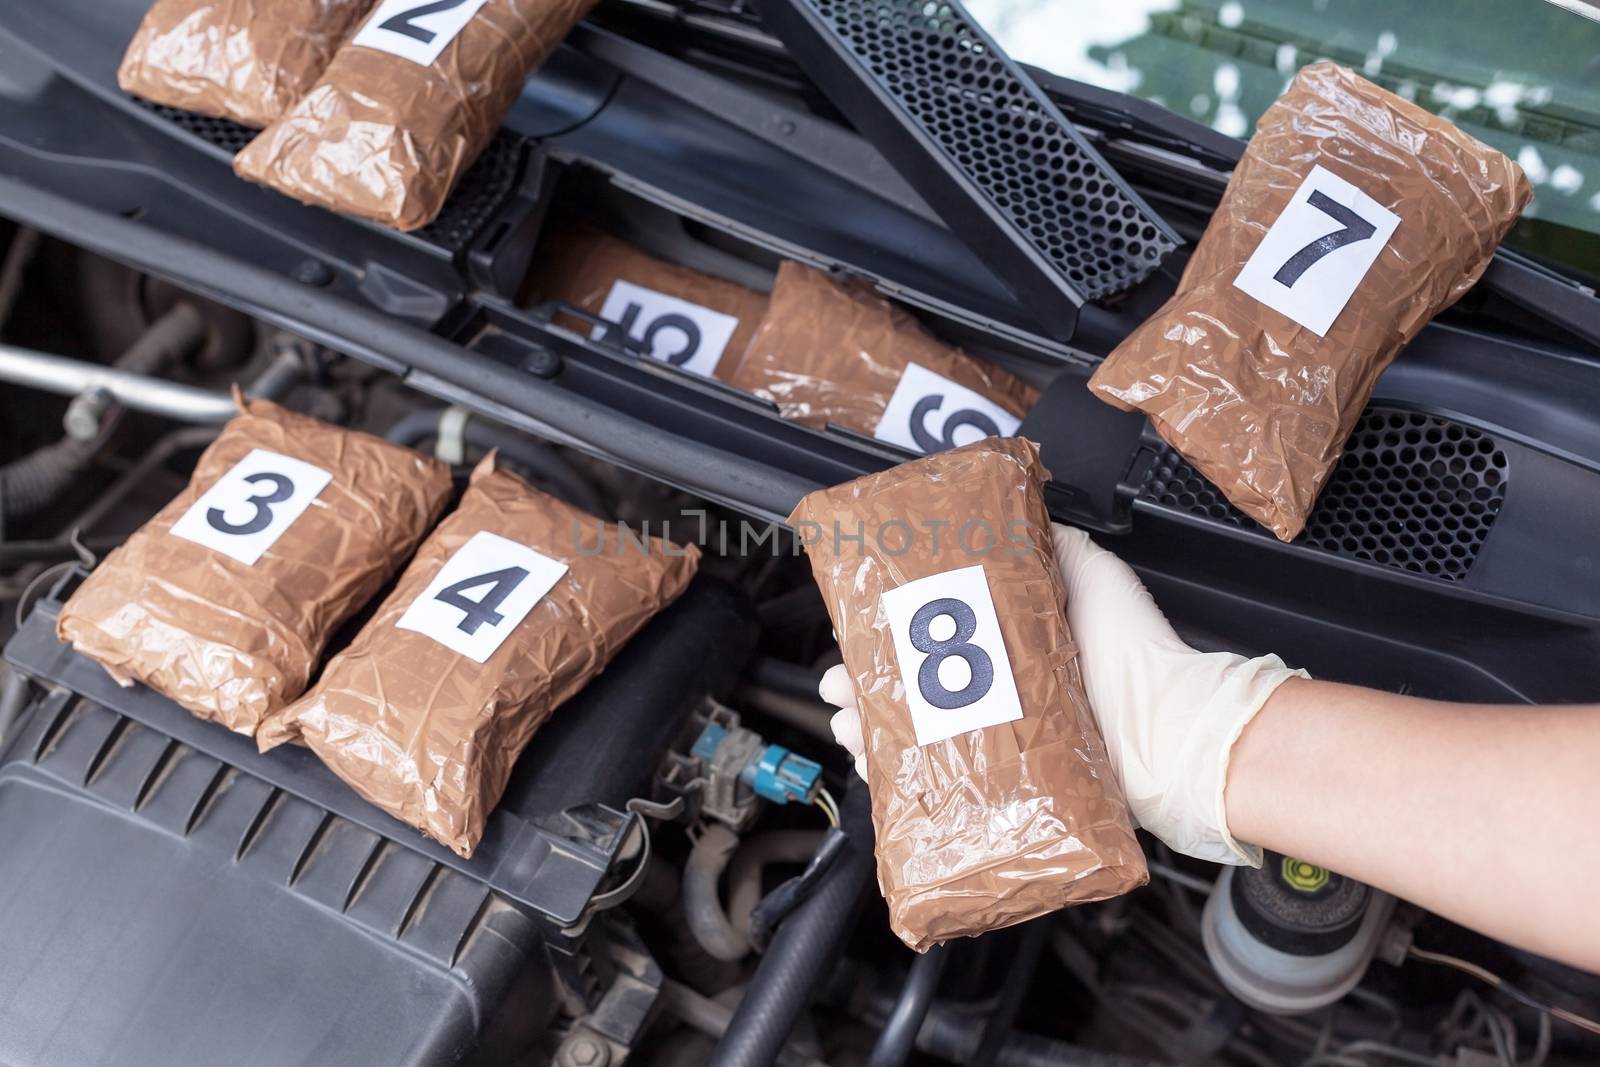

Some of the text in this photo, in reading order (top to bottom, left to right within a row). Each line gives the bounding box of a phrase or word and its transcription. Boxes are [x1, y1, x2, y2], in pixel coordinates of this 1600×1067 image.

[1272, 188, 1378, 289] 7
[619, 302, 702, 366] 5
[910, 394, 1001, 454] 6
[206, 472, 295, 535] 3
[434, 566, 530, 636] 4
[908, 597, 994, 710] 8
